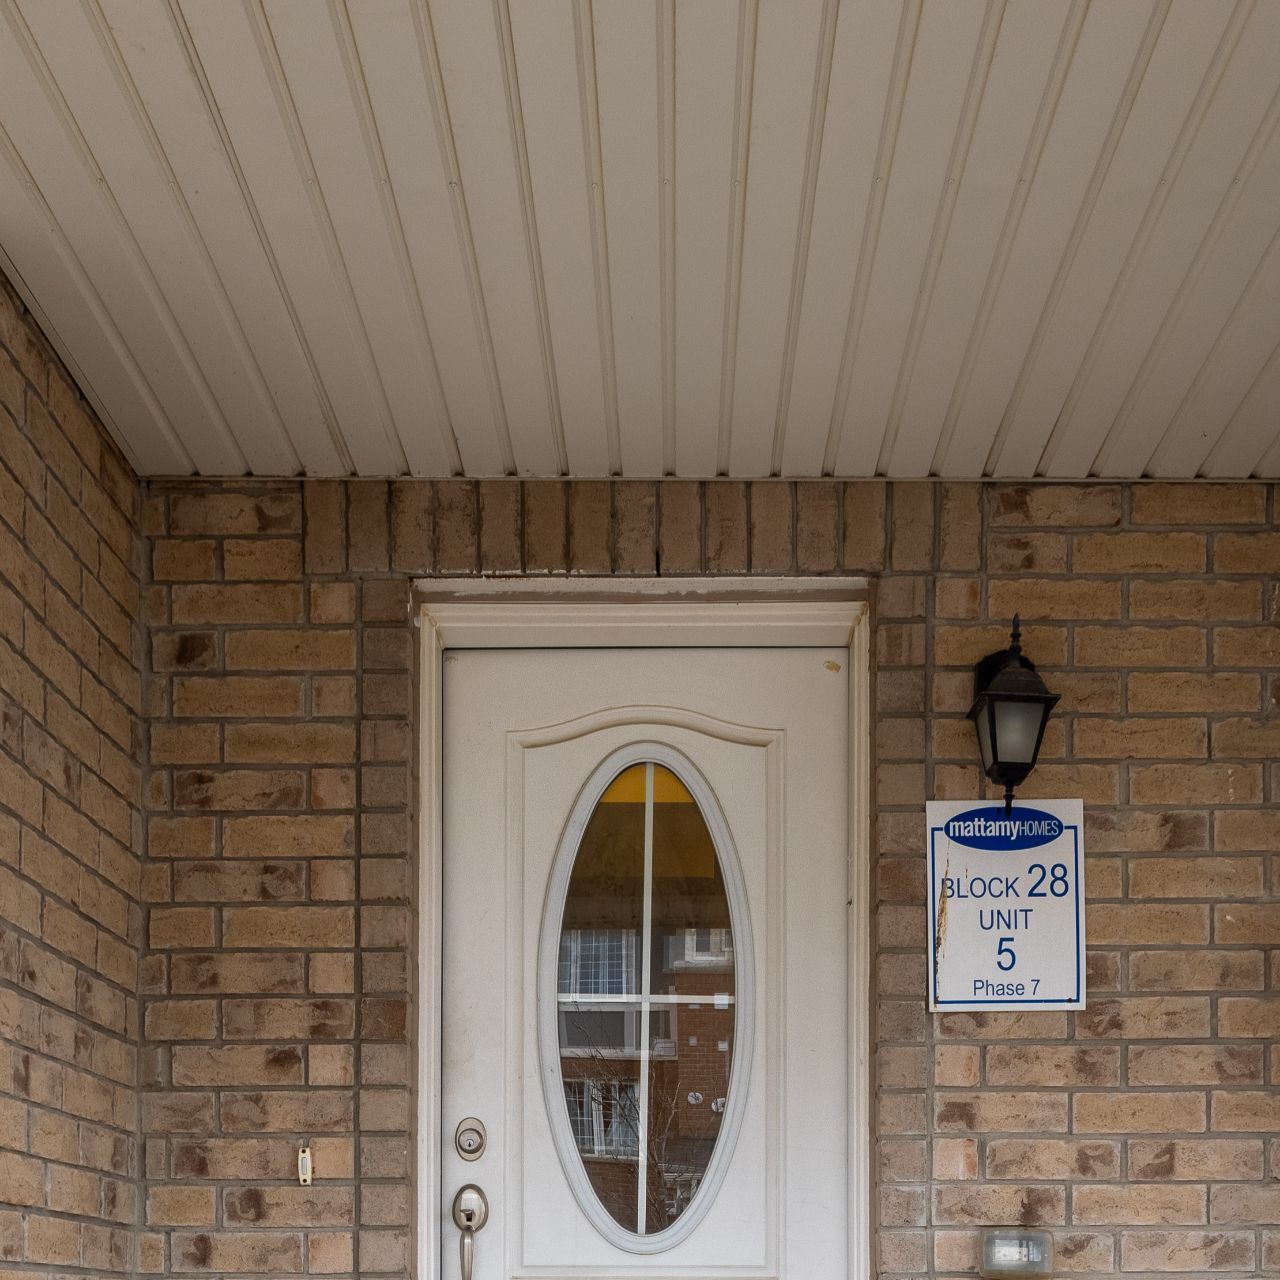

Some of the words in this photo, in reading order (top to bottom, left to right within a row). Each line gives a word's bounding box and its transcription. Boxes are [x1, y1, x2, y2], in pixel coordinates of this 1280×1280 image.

[949, 817, 1060, 840] mattamyHOMES
[941, 877, 1020, 899] BLOCK
[1027, 863, 1069, 898] 28
[979, 908, 1034, 931] UNIT
[996, 937, 1017, 971] 5
[973, 979, 1025, 997] Phase
[1030, 979, 1041, 996] 7
